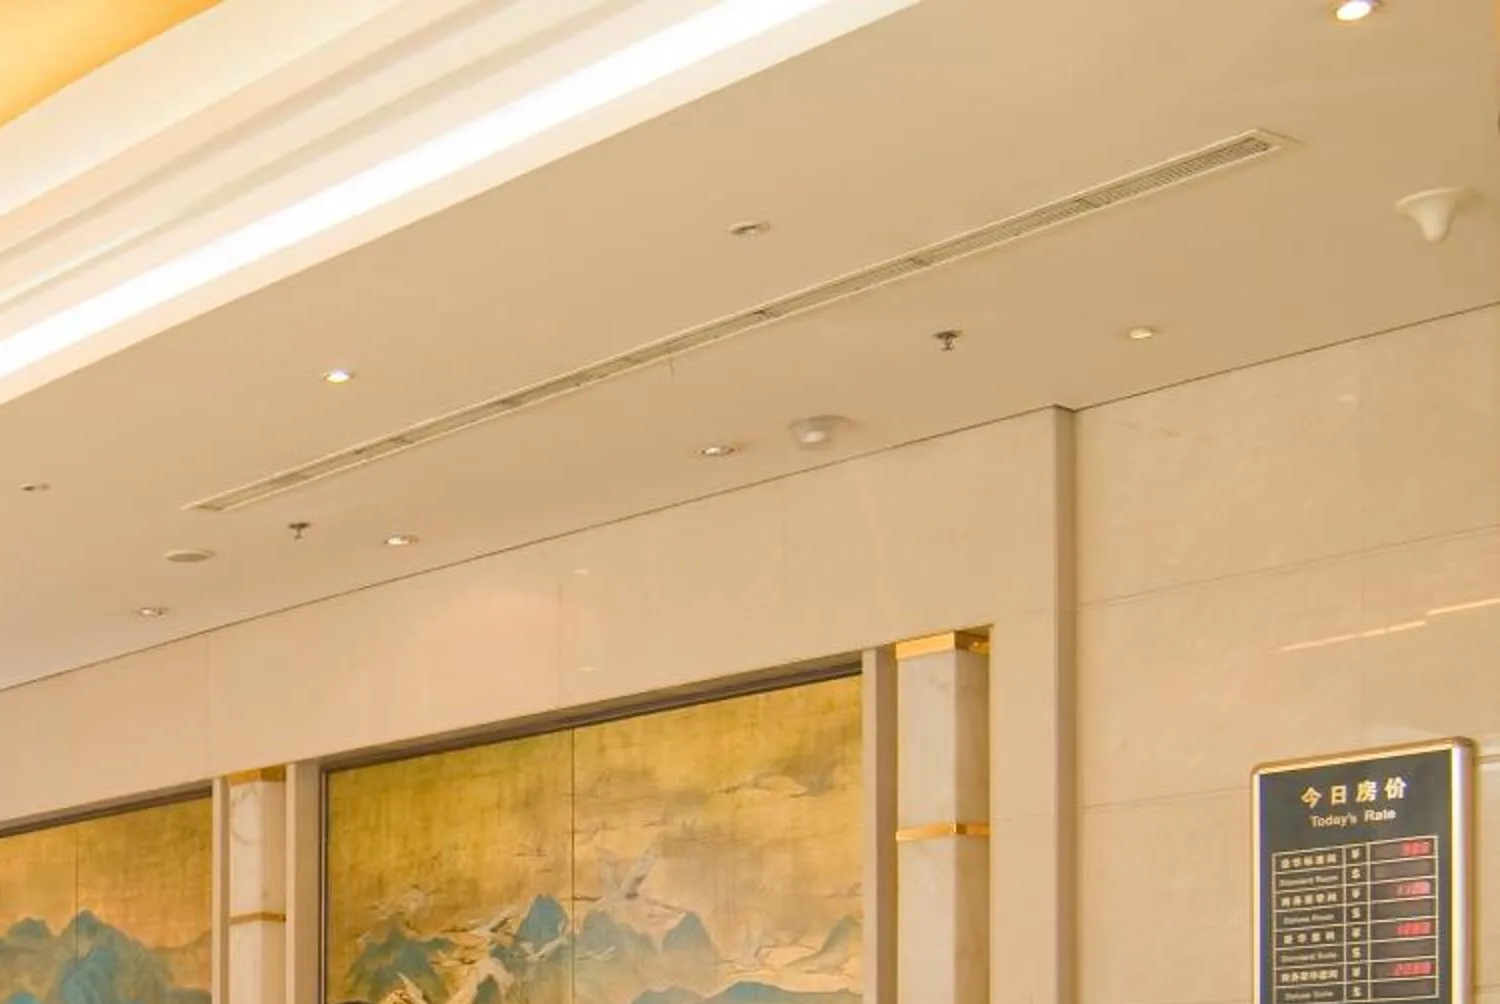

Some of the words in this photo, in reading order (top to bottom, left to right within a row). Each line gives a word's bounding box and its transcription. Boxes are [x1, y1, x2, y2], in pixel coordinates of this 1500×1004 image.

[1300, 777, 1406, 809] 今日房价
[1310, 812, 1358, 828] Today's
[1364, 808, 1397, 822] Rate
